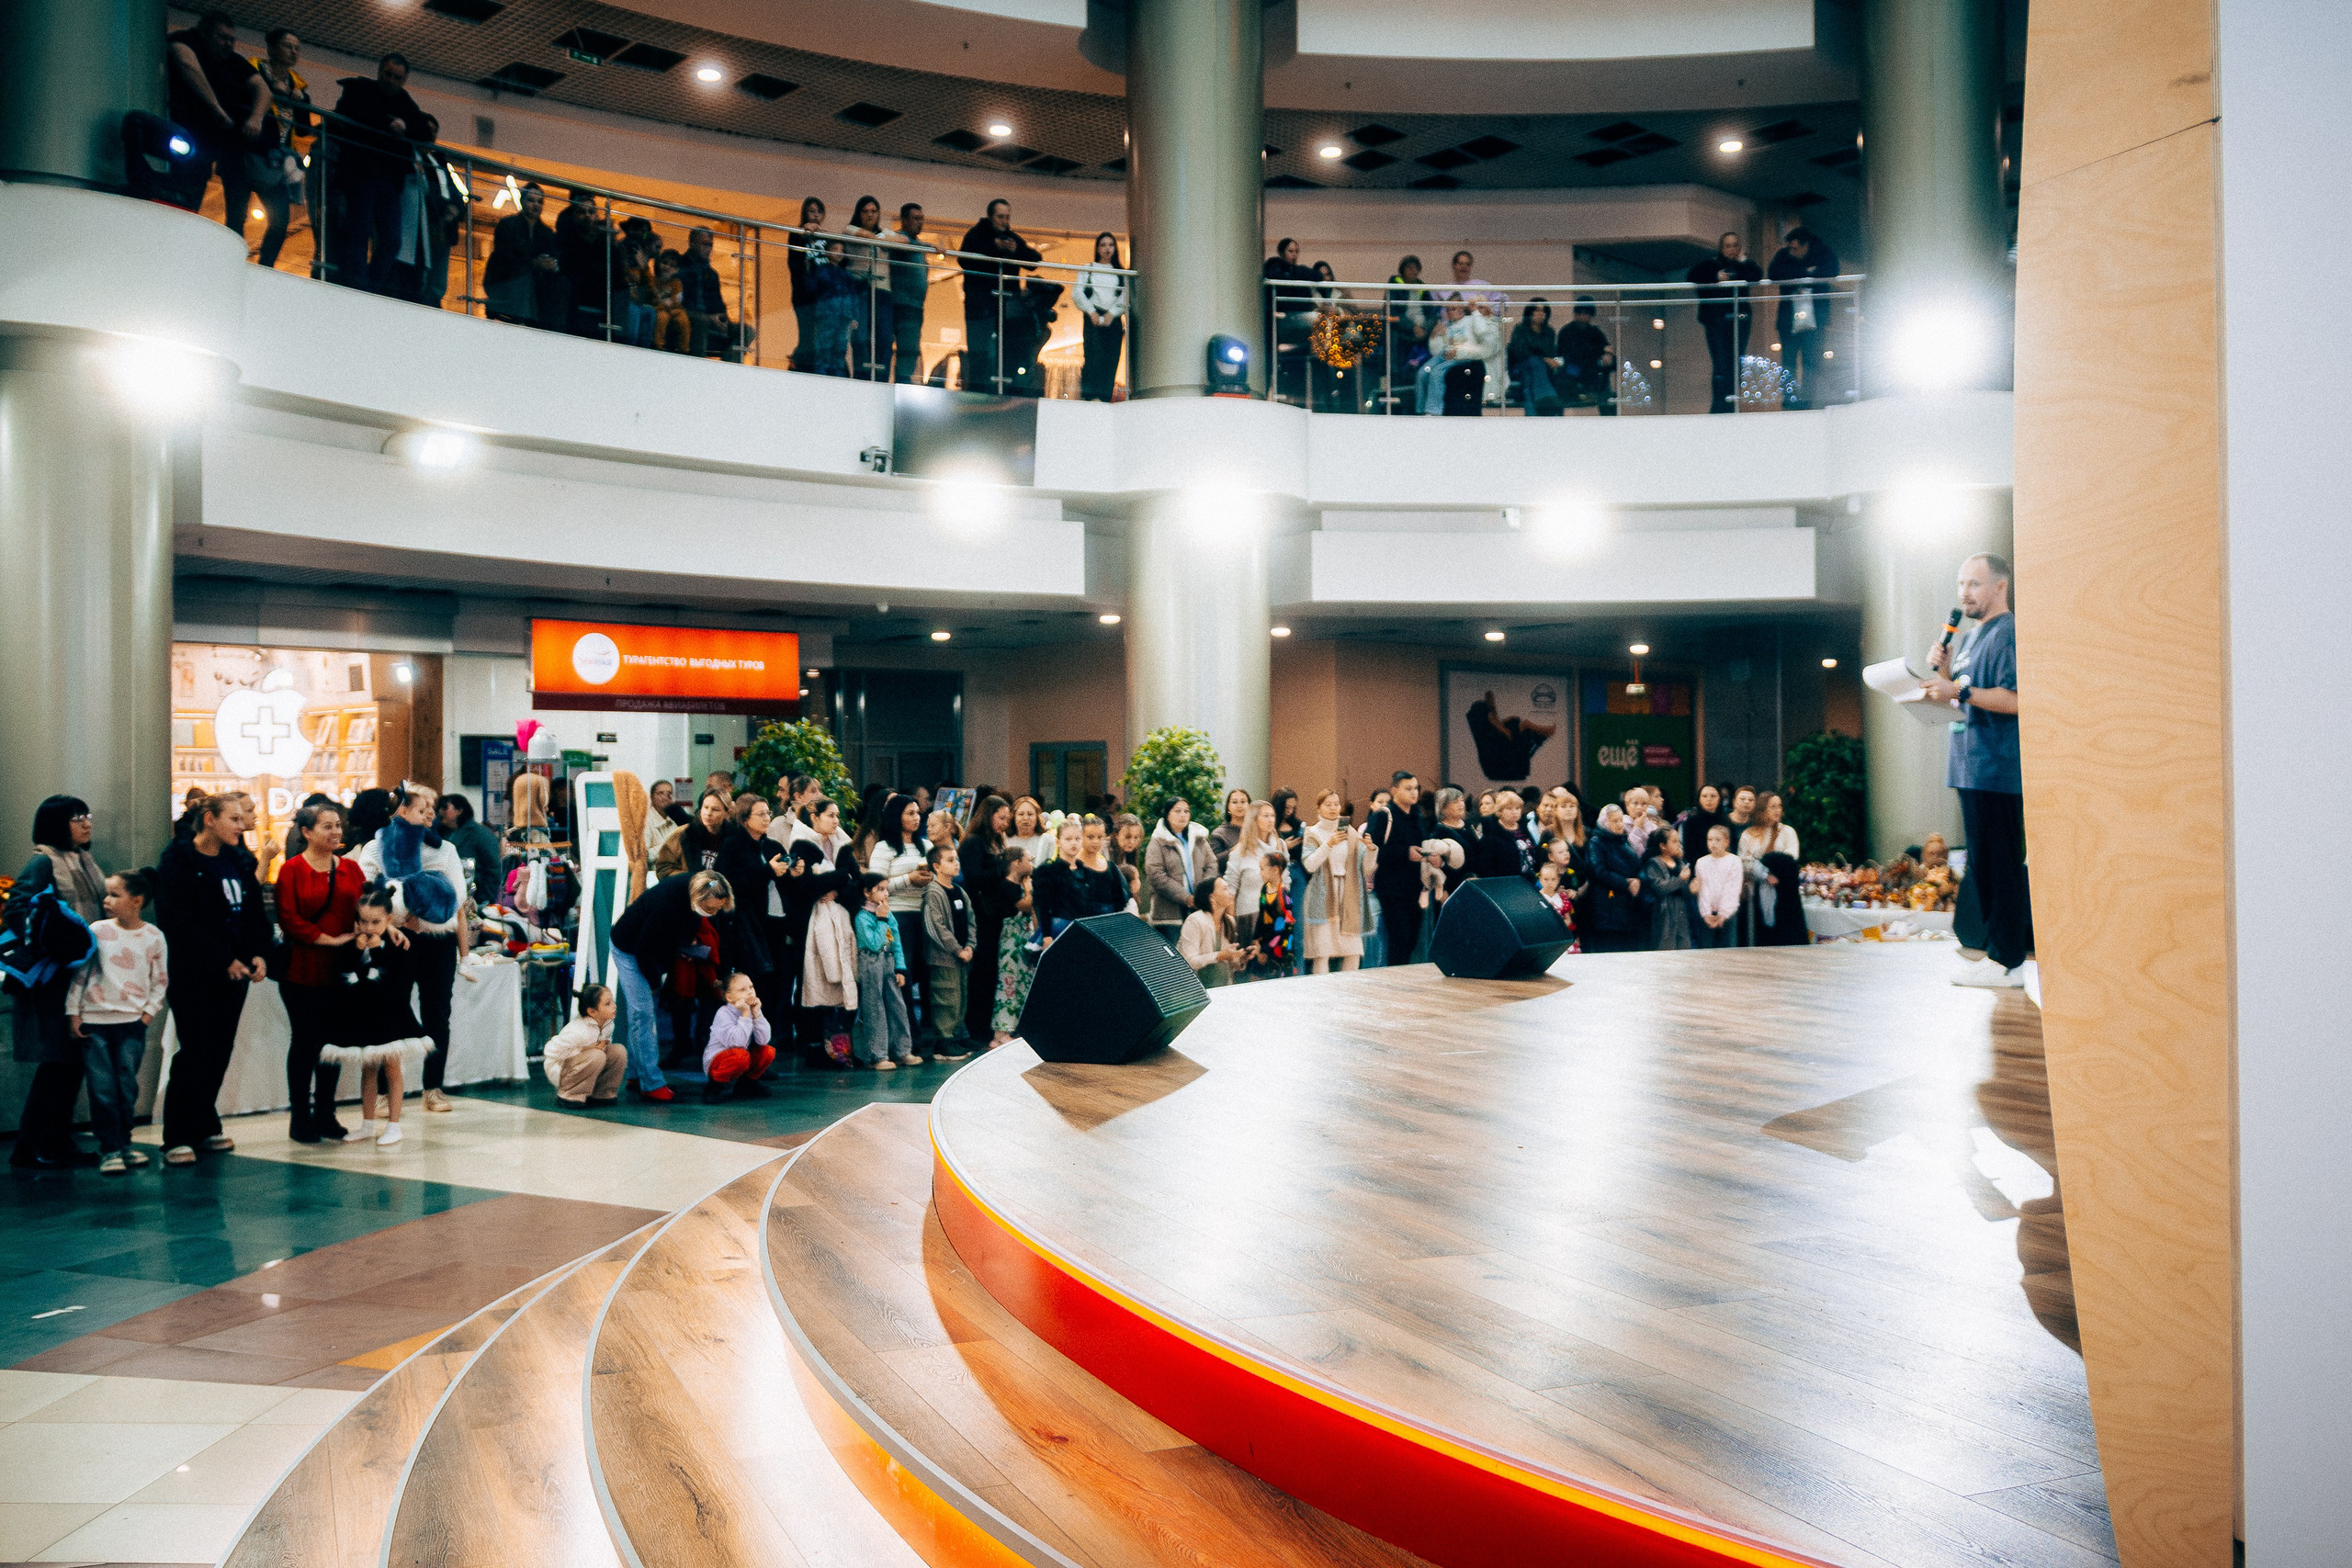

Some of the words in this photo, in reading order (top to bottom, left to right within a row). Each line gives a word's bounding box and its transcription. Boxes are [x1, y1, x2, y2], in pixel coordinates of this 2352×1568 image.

[623, 654, 687, 668] ТУРАГЕНТСТВО
[689, 657, 737, 671] ВЫГОДНЫХ
[738, 660, 765, 671] ТУРОВ
[615, 698, 661, 710] ПРОДАЖА
[486, 747, 509, 756] SALE
